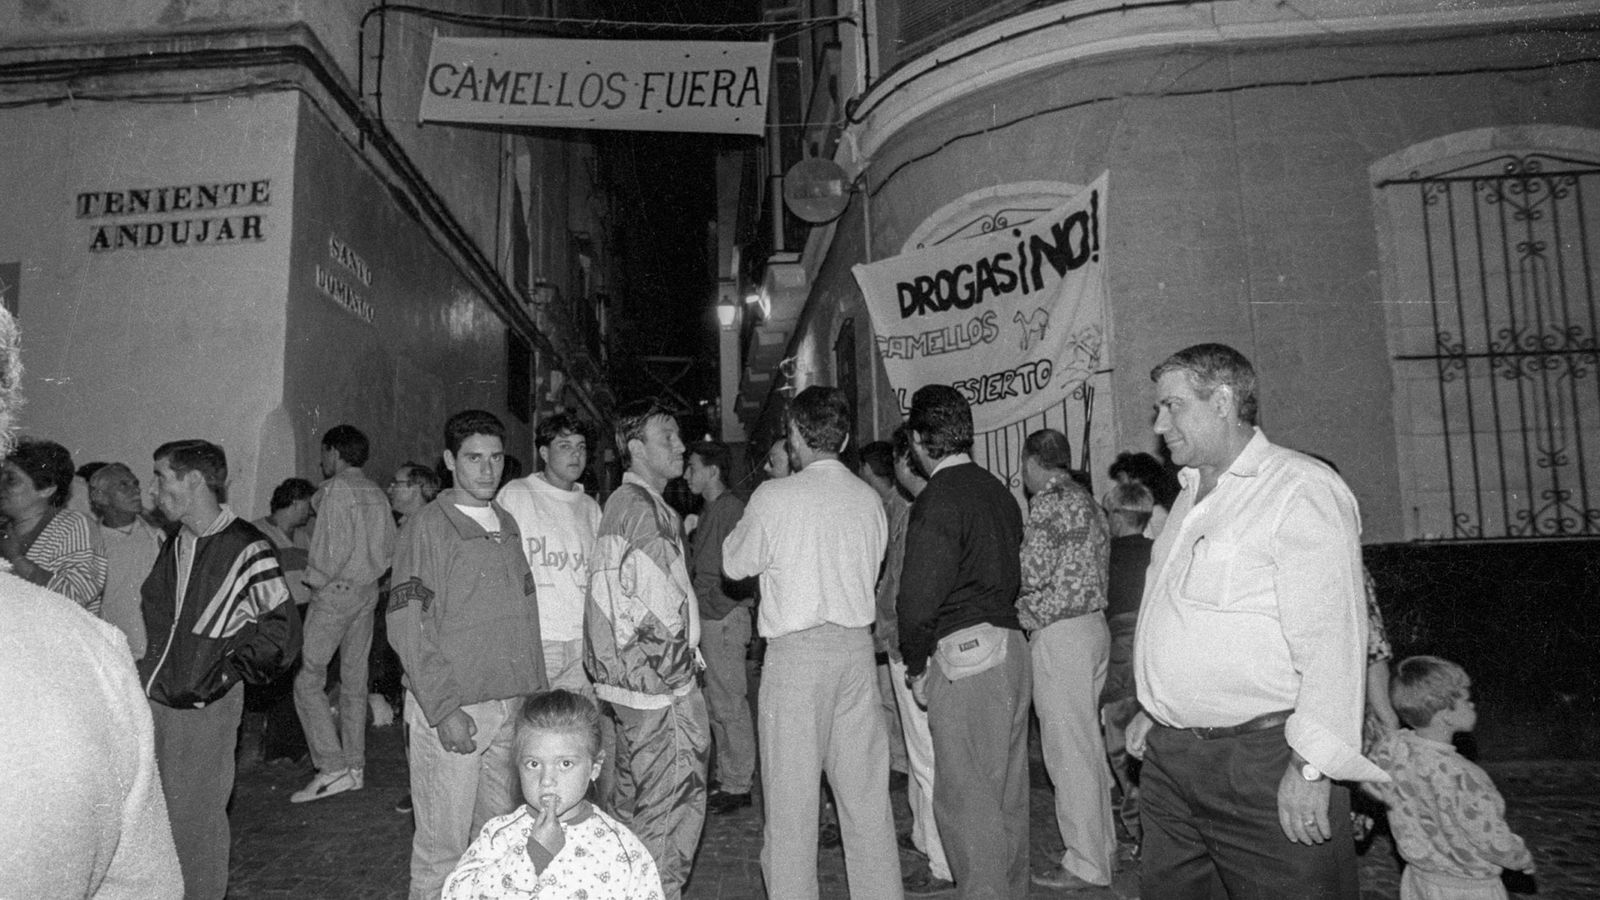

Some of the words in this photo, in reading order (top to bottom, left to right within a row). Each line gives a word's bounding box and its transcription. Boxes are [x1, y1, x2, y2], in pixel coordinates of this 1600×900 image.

[638, 66, 763, 110] FUERA
[77, 181, 270, 217] TENIENTE
[89, 214, 264, 250] ANDUJAR
[897, 252, 1018, 319] DROGAS
[952, 359, 1053, 406] SIERTO
